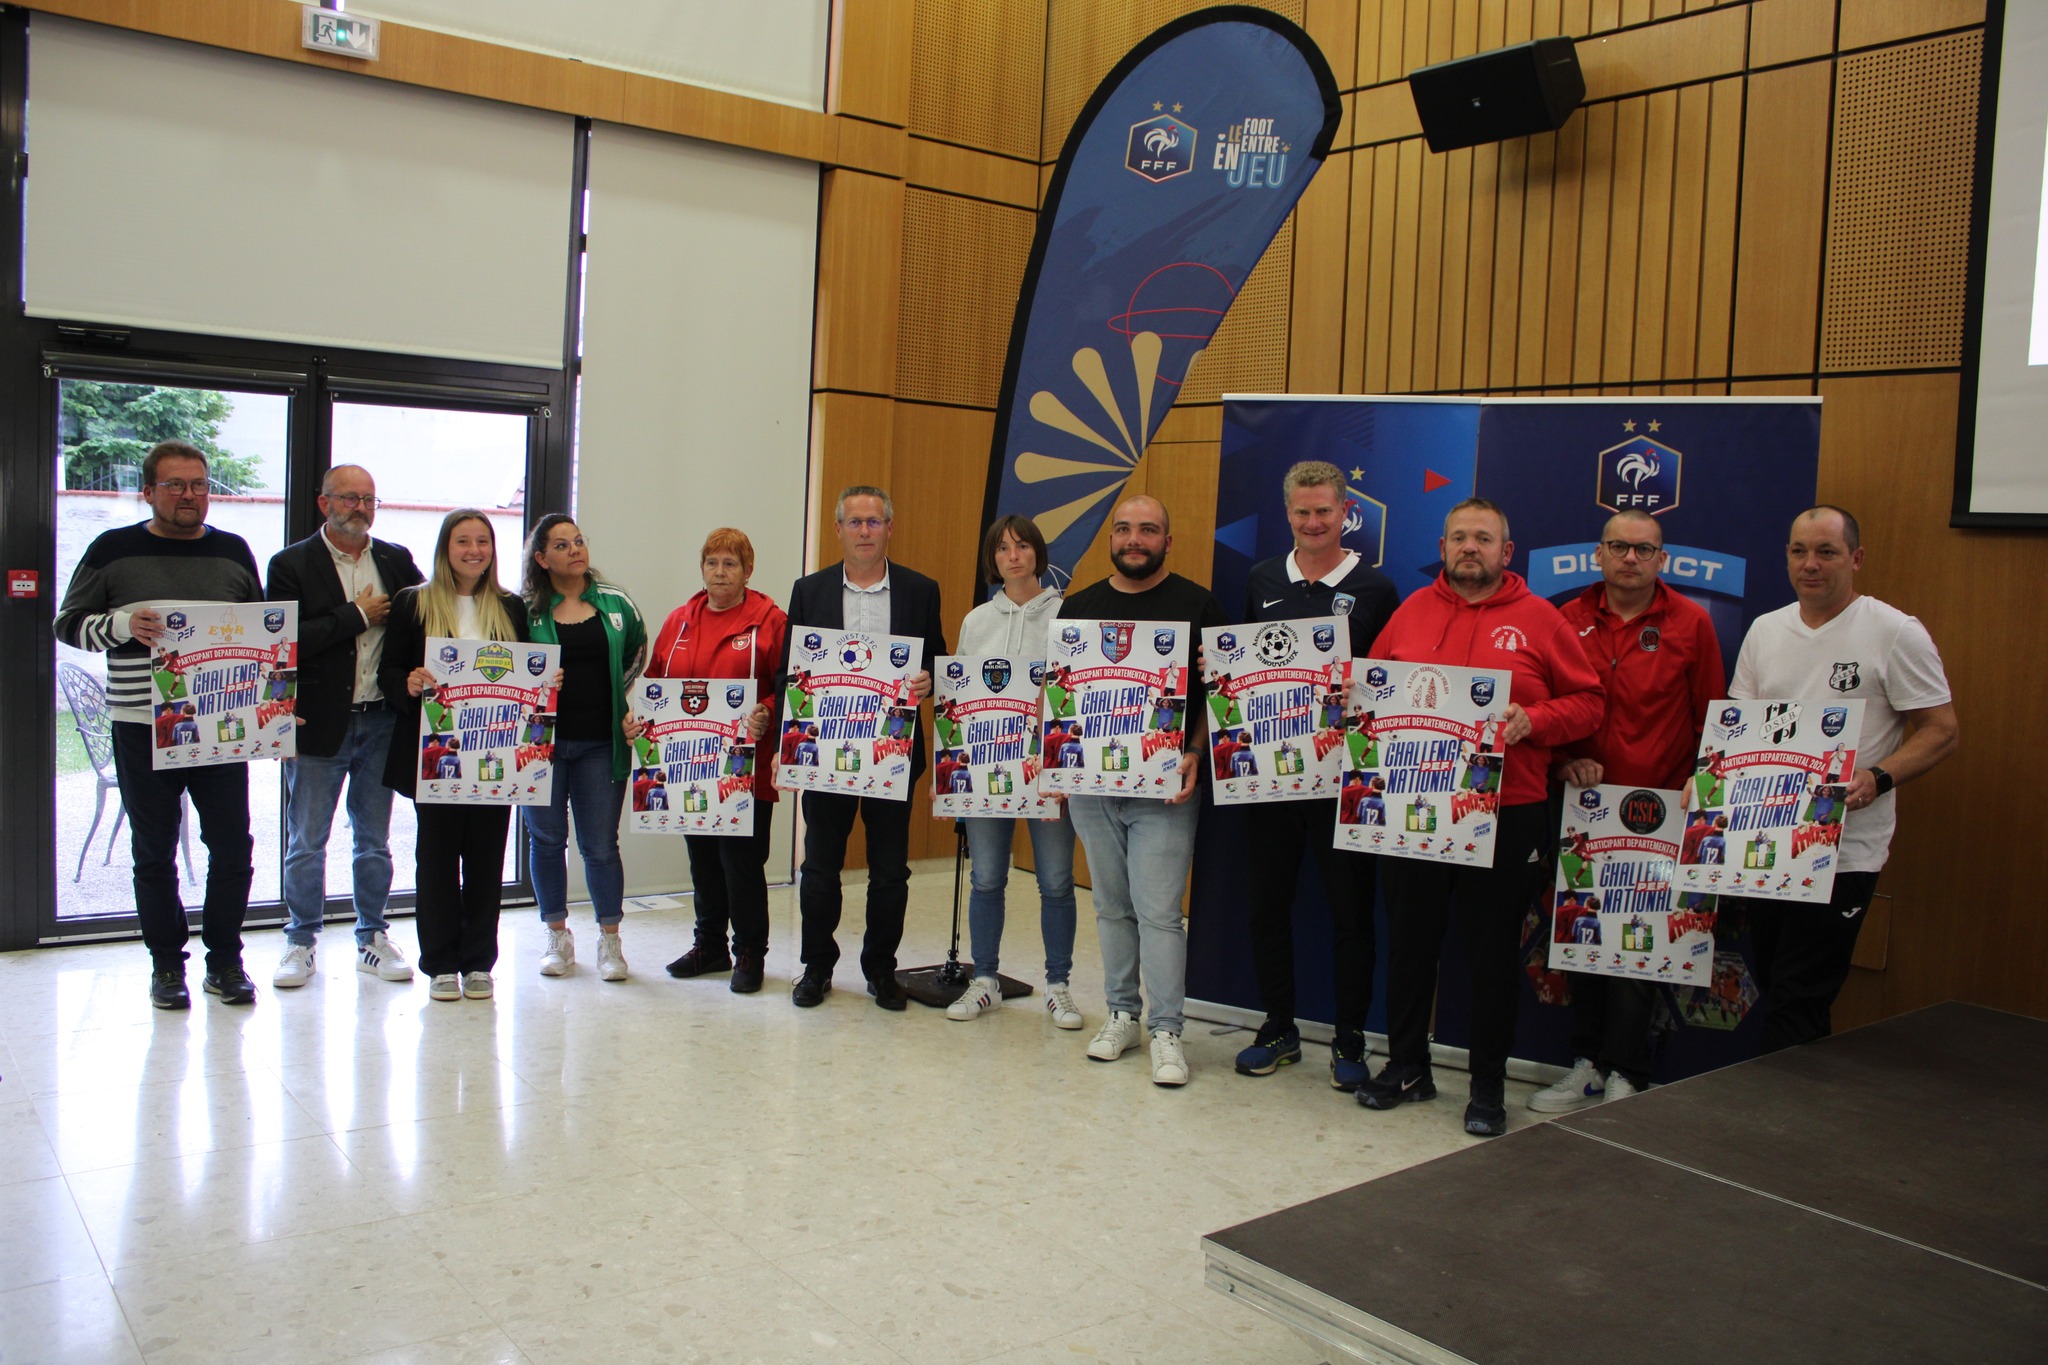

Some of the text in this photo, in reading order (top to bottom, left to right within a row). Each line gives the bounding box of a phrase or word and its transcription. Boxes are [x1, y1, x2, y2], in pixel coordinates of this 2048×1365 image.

[1228, 118, 1275, 143] LE FOOT
[1241, 135, 1281, 153] ENTRE
[1213, 141, 1240, 170] EN
[1141, 160, 1177, 171] FFF
[1227, 153, 1288, 189] JEU
[1616, 494, 1660, 507] FFF
[1553, 554, 1723, 581] DISICT
[177, 626, 196, 642] PEF
[836, 633, 859, 646] OUEST
[860, 634, 870, 642] 52
[868, 639, 878, 650] FC
[1252, 622, 1299, 647] Association Sportive
[811, 649, 829, 662] PEF
[1070, 641, 1088, 657] PEF
[1229, 647, 1245, 664] PEF
[177, 651, 213, 667] PARTICIPANT
[261, 652, 275, 661] 2024
[1255, 650, 1299, 668] ESNOUVEAUX
[449, 661, 465, 675] PEF
[955, 675, 971, 691] PEF
[1068, 668, 1103, 683] PARTICIPANT
[1148, 675, 1163, 686] 2024
[1314, 673, 1329, 684] 2024
[444, 685, 471, 700] LAURÉAT
[521, 691, 538, 704] 2024
[808, 675, 841, 687] PARTICIPANT
[882, 685, 897, 697] 2024
[1375, 685, 1396, 701] PEF
[654, 697, 669, 711] PEF
[1027, 705, 1038, 714] 202
[652, 721, 683, 735] PARTICIPANT
[722, 727, 735, 736] 2024
[1371, 717, 1412, 731] PARTICIPANT
[1462, 727, 1479, 740] 2024
[1727, 723, 1748, 741] PEF
[1720, 753, 1759, 770] PARTICIPANT
[1809, 759, 1827, 773] 2024
[1589, 807, 1610, 823] PEF
[1628, 800, 1659, 824] CSC
[1585, 838, 1626, 852] PARTICIPANT
